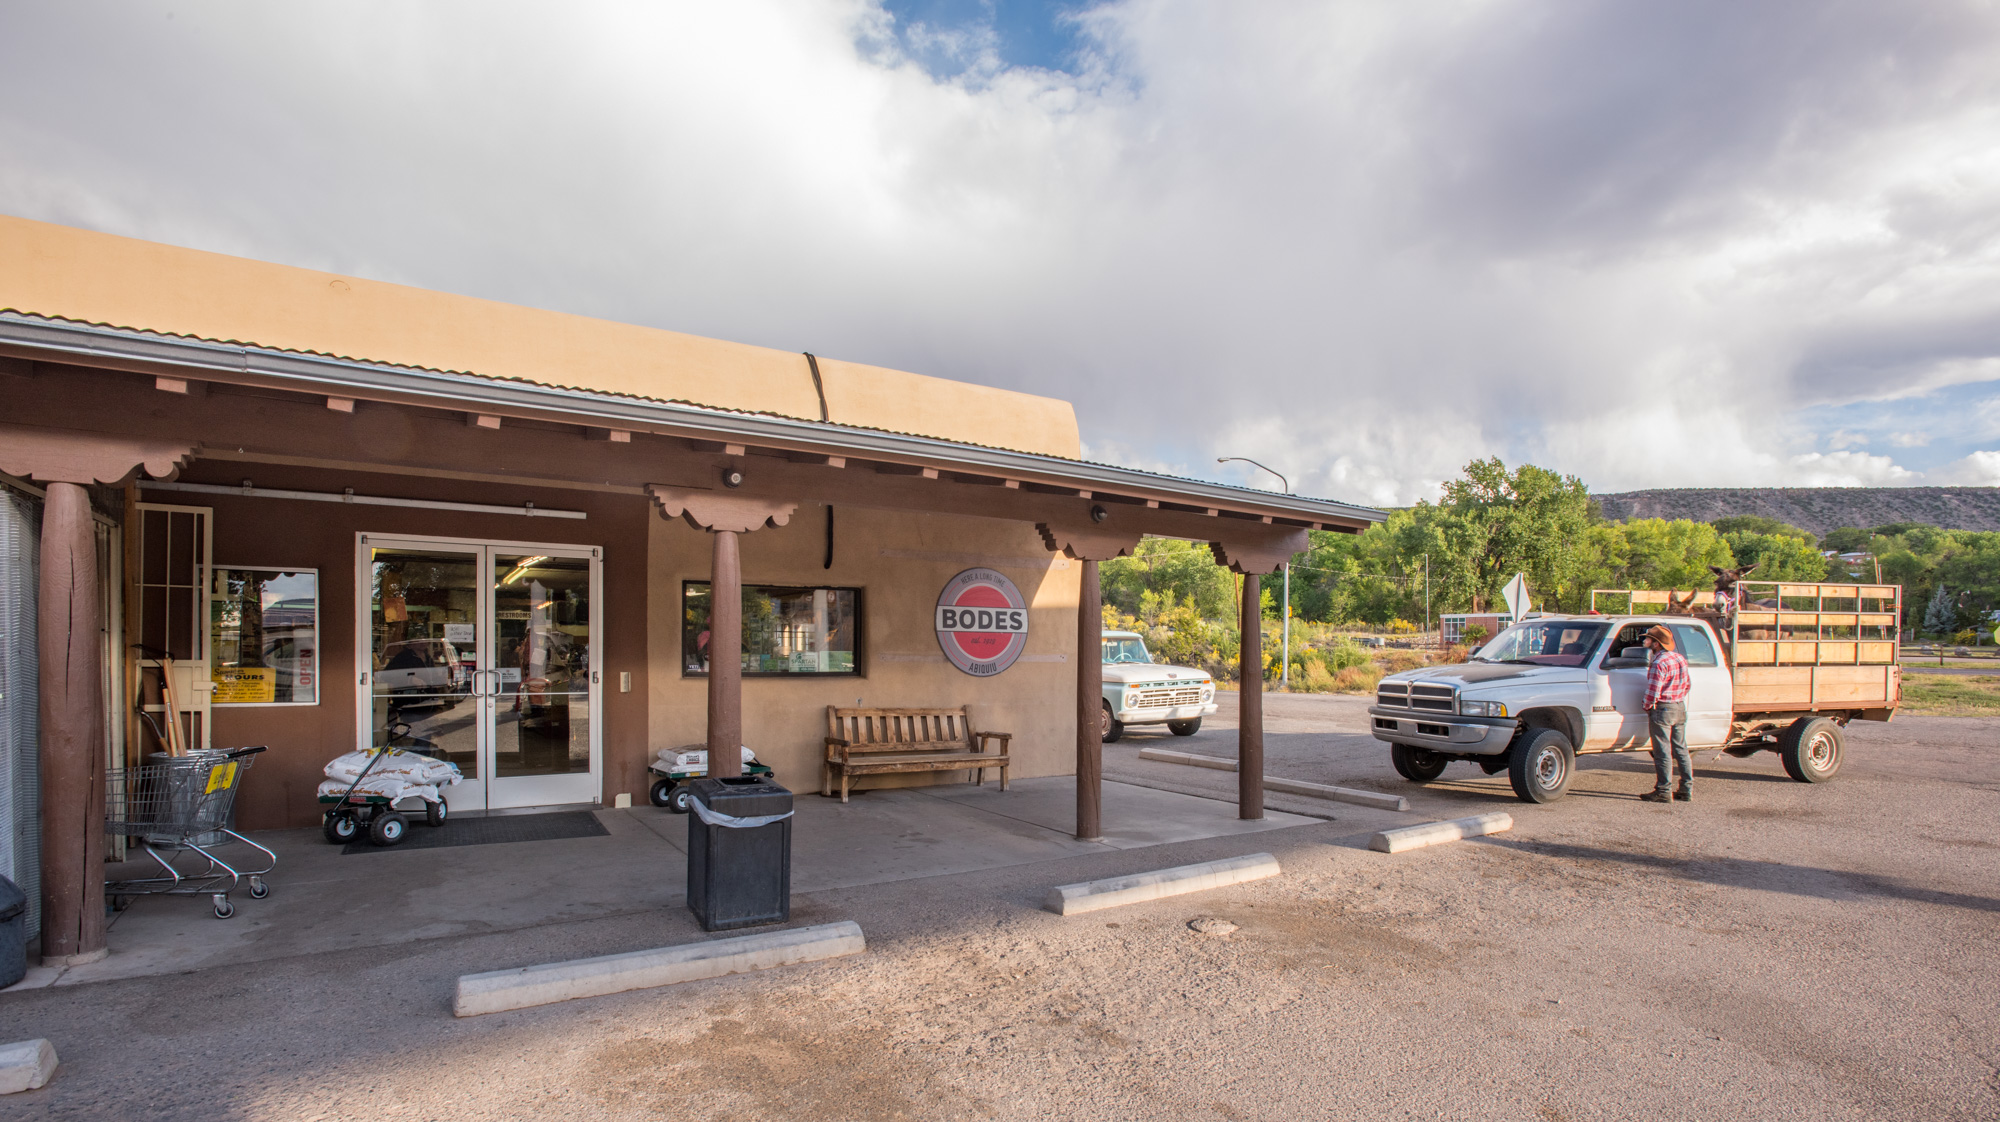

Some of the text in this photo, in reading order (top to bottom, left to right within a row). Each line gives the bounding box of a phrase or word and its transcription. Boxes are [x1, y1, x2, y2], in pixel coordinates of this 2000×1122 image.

[960, 573, 974, 585] HERE
[980, 573, 993, 581] LONG
[993, 575, 1006, 587] TIME
[942, 608, 1023, 631] BODES
[299, 649, 312, 686] OPEN
[968, 662, 998, 674] ABIQUIU
